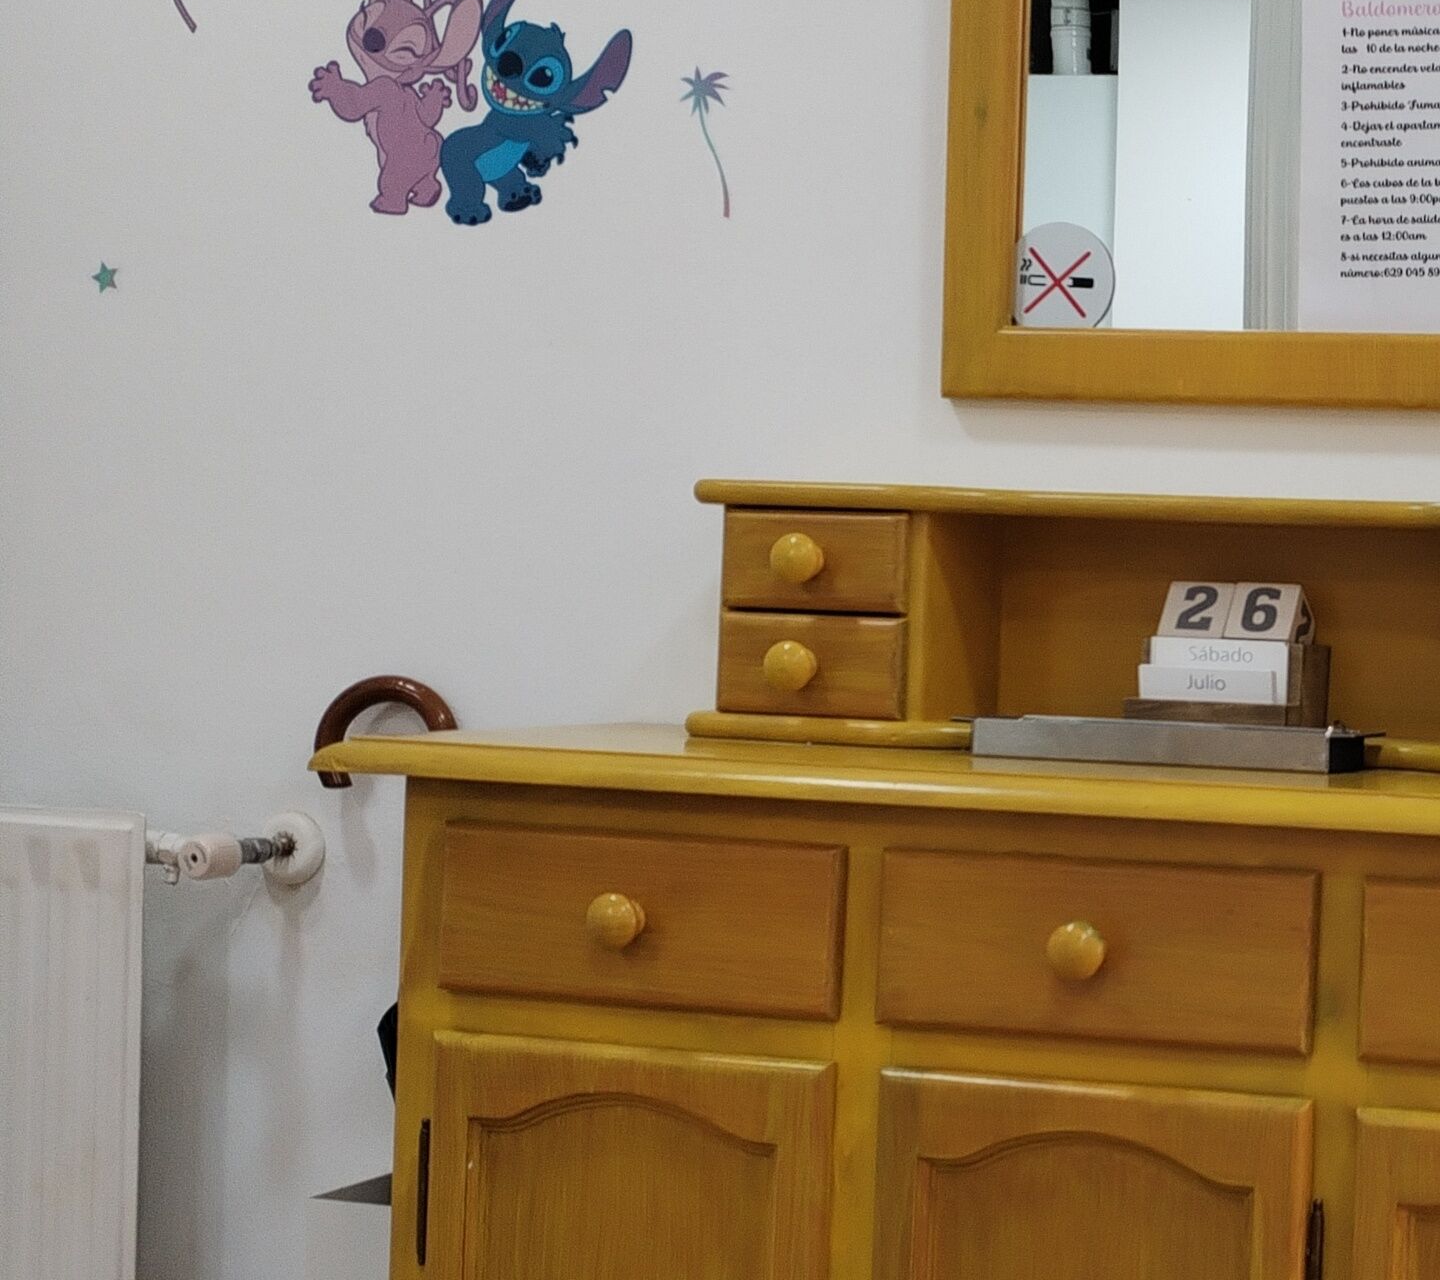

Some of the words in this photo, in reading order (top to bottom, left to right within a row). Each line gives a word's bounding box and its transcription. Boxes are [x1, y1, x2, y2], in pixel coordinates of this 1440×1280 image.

[1368, 27, 1400, 40] poner
[1341, 43, 1358, 54] las
[1366, 43, 1377, 54] 10
[1379, 43, 1392, 54] de
[1394, 43, 1406, 53] la
[1407, 42, 1440, 53] noche
[1369, 64, 1418, 74] encender
[1340, 80, 1406, 94] inflamables
[1385, 120, 1394, 130] el
[1340, 137, 1402, 148] encontraste
[1372, 177, 1404, 188] cubos
[1405, 177, 1420, 187] de
[1421, 177, 1433, 187] la
[1340, 194, 1379, 207] puestos
[1381, 195, 1389, 204] a
[1390, 194, 1407, 204] las
[1368, 214, 1394, 225] hora
[1396, 214, 1409, 224] de
[1340, 233, 1351, 241] es
[1352, 233, 1361, 241] a
[1362, 231, 1378, 241] las
[1362, 251, 1408, 262] necesitas
[1188, 645, 1254, 664] Sábado
[1186, 674, 1227, 693] Julio
